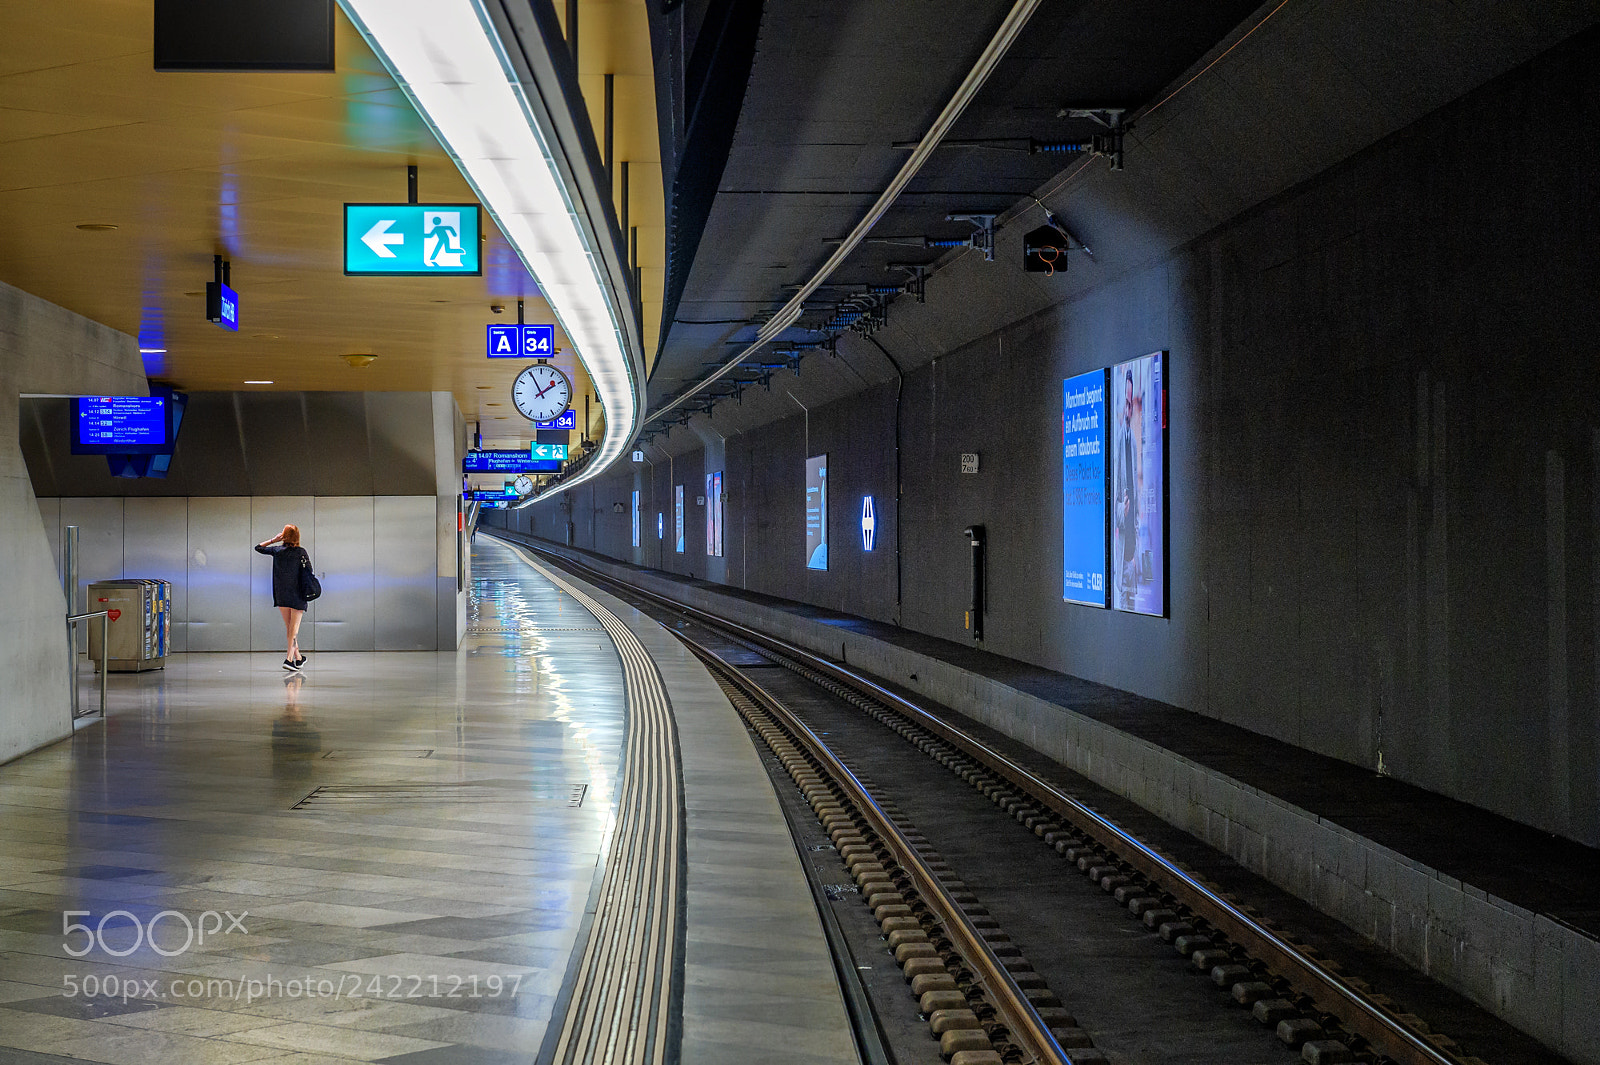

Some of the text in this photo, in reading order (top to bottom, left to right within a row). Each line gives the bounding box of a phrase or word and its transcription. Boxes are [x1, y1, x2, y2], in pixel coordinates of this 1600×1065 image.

[496, 335, 512, 352] A
[526, 337, 549, 352] 34
[1065, 385, 1102, 409] Manchmal beginnt
[558, 417, 573, 427] 34
[1072, 411, 1091, 433] Aufbruch
[1090, 410, 1099, 430] mit
[1065, 440, 1078, 458] einem
[1091, 572, 1103, 591] CLER
